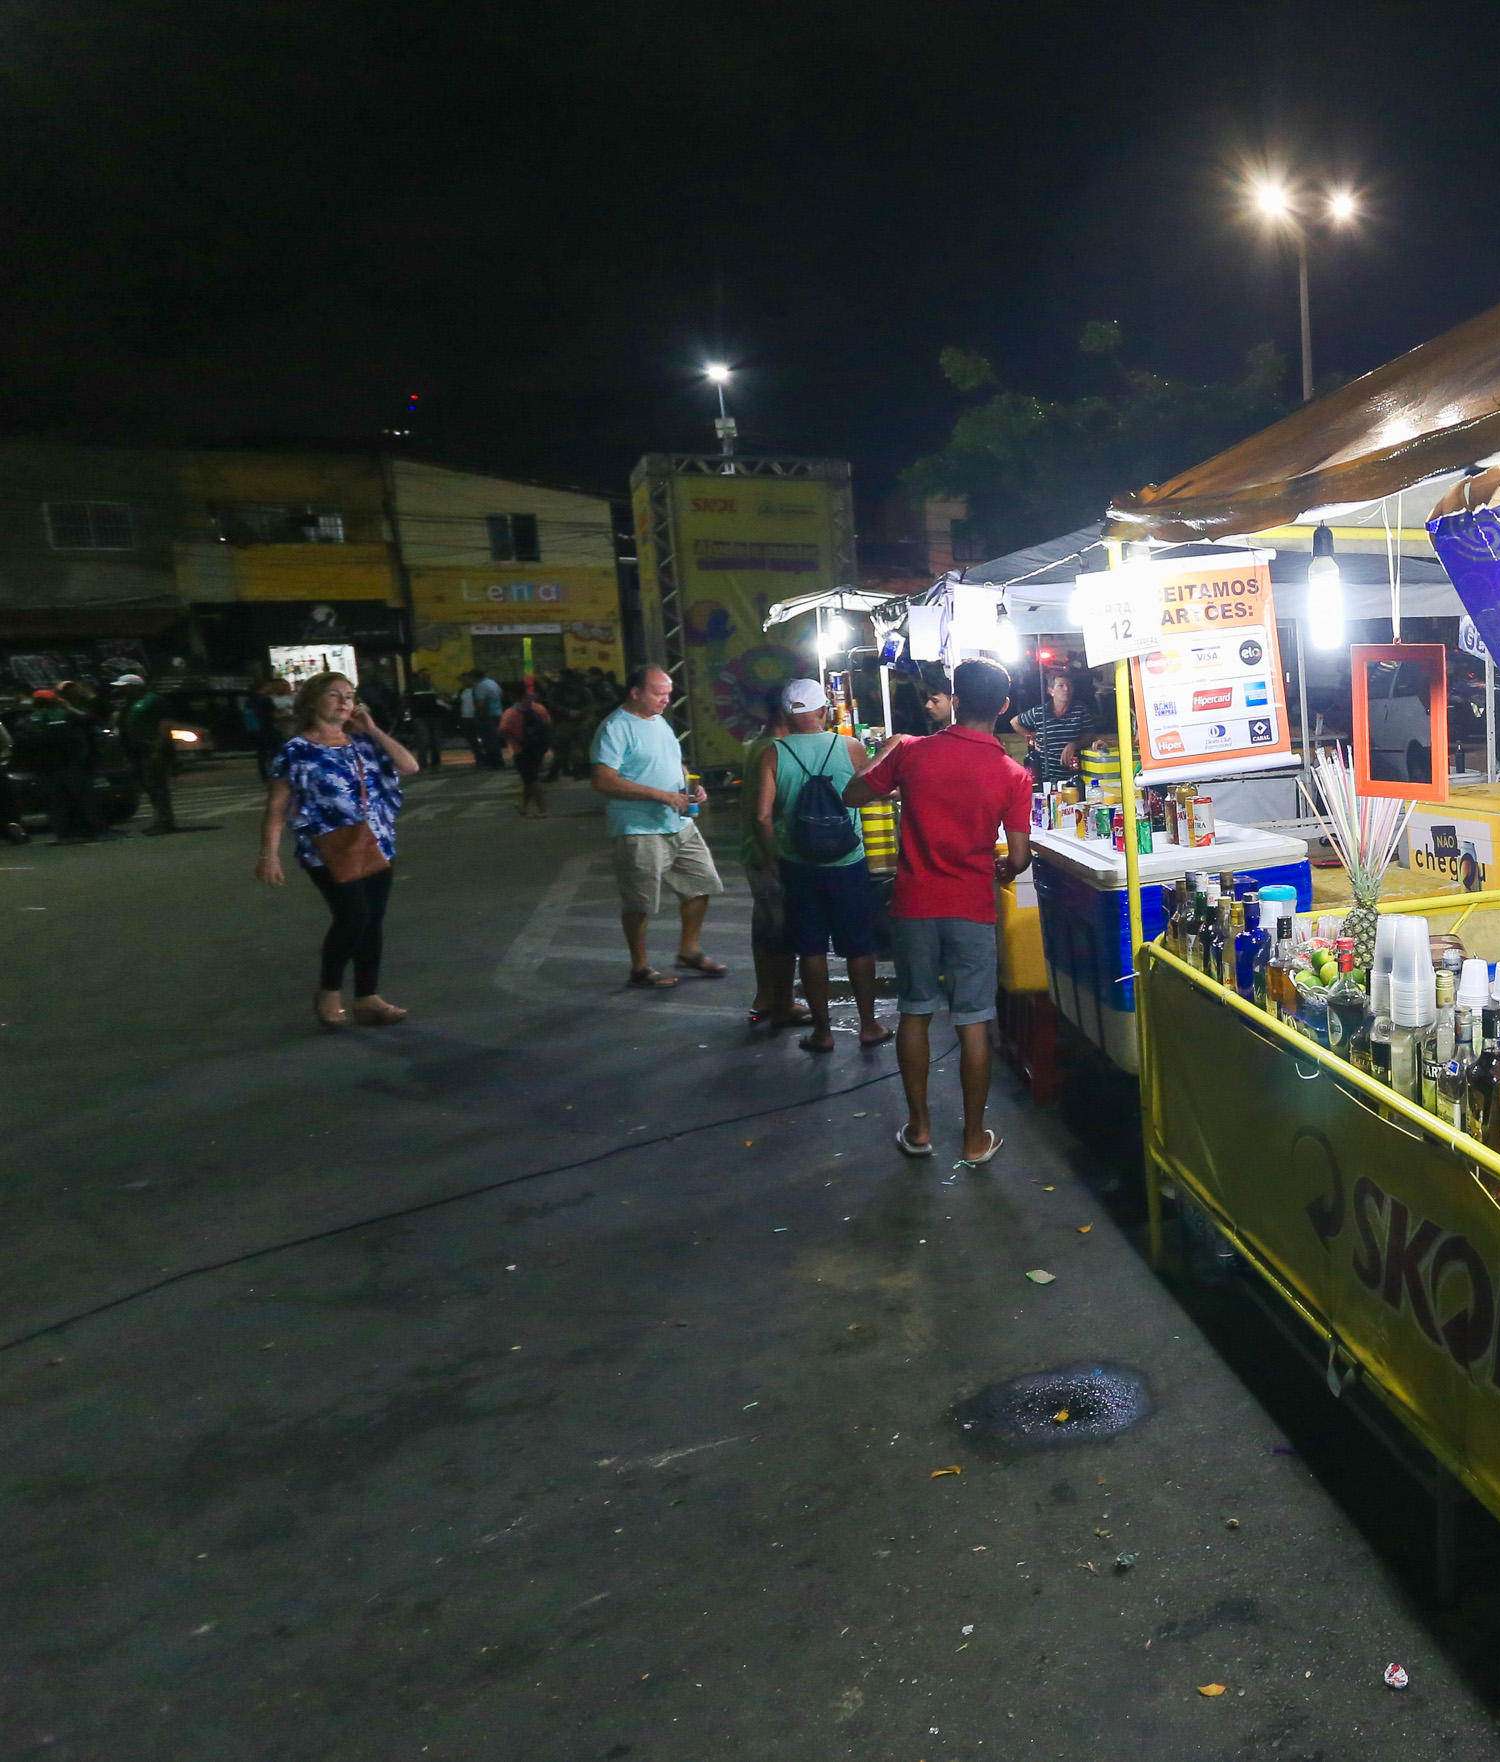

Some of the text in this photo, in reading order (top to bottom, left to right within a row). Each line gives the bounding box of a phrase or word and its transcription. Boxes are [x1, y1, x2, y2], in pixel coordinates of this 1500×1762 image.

[461, 578, 558, 602] Lena
[1161, 578, 1260, 602] EITAMOS
[1110, 618, 1133, 641] 12
[1196, 652, 1219, 662] VISA
[1240, 646, 1261, 660] elo
[1193, 692, 1232, 707] Hipercard
[1158, 740, 1182, 751] Hiper
[1436, 832, 1455, 849] NÃO
